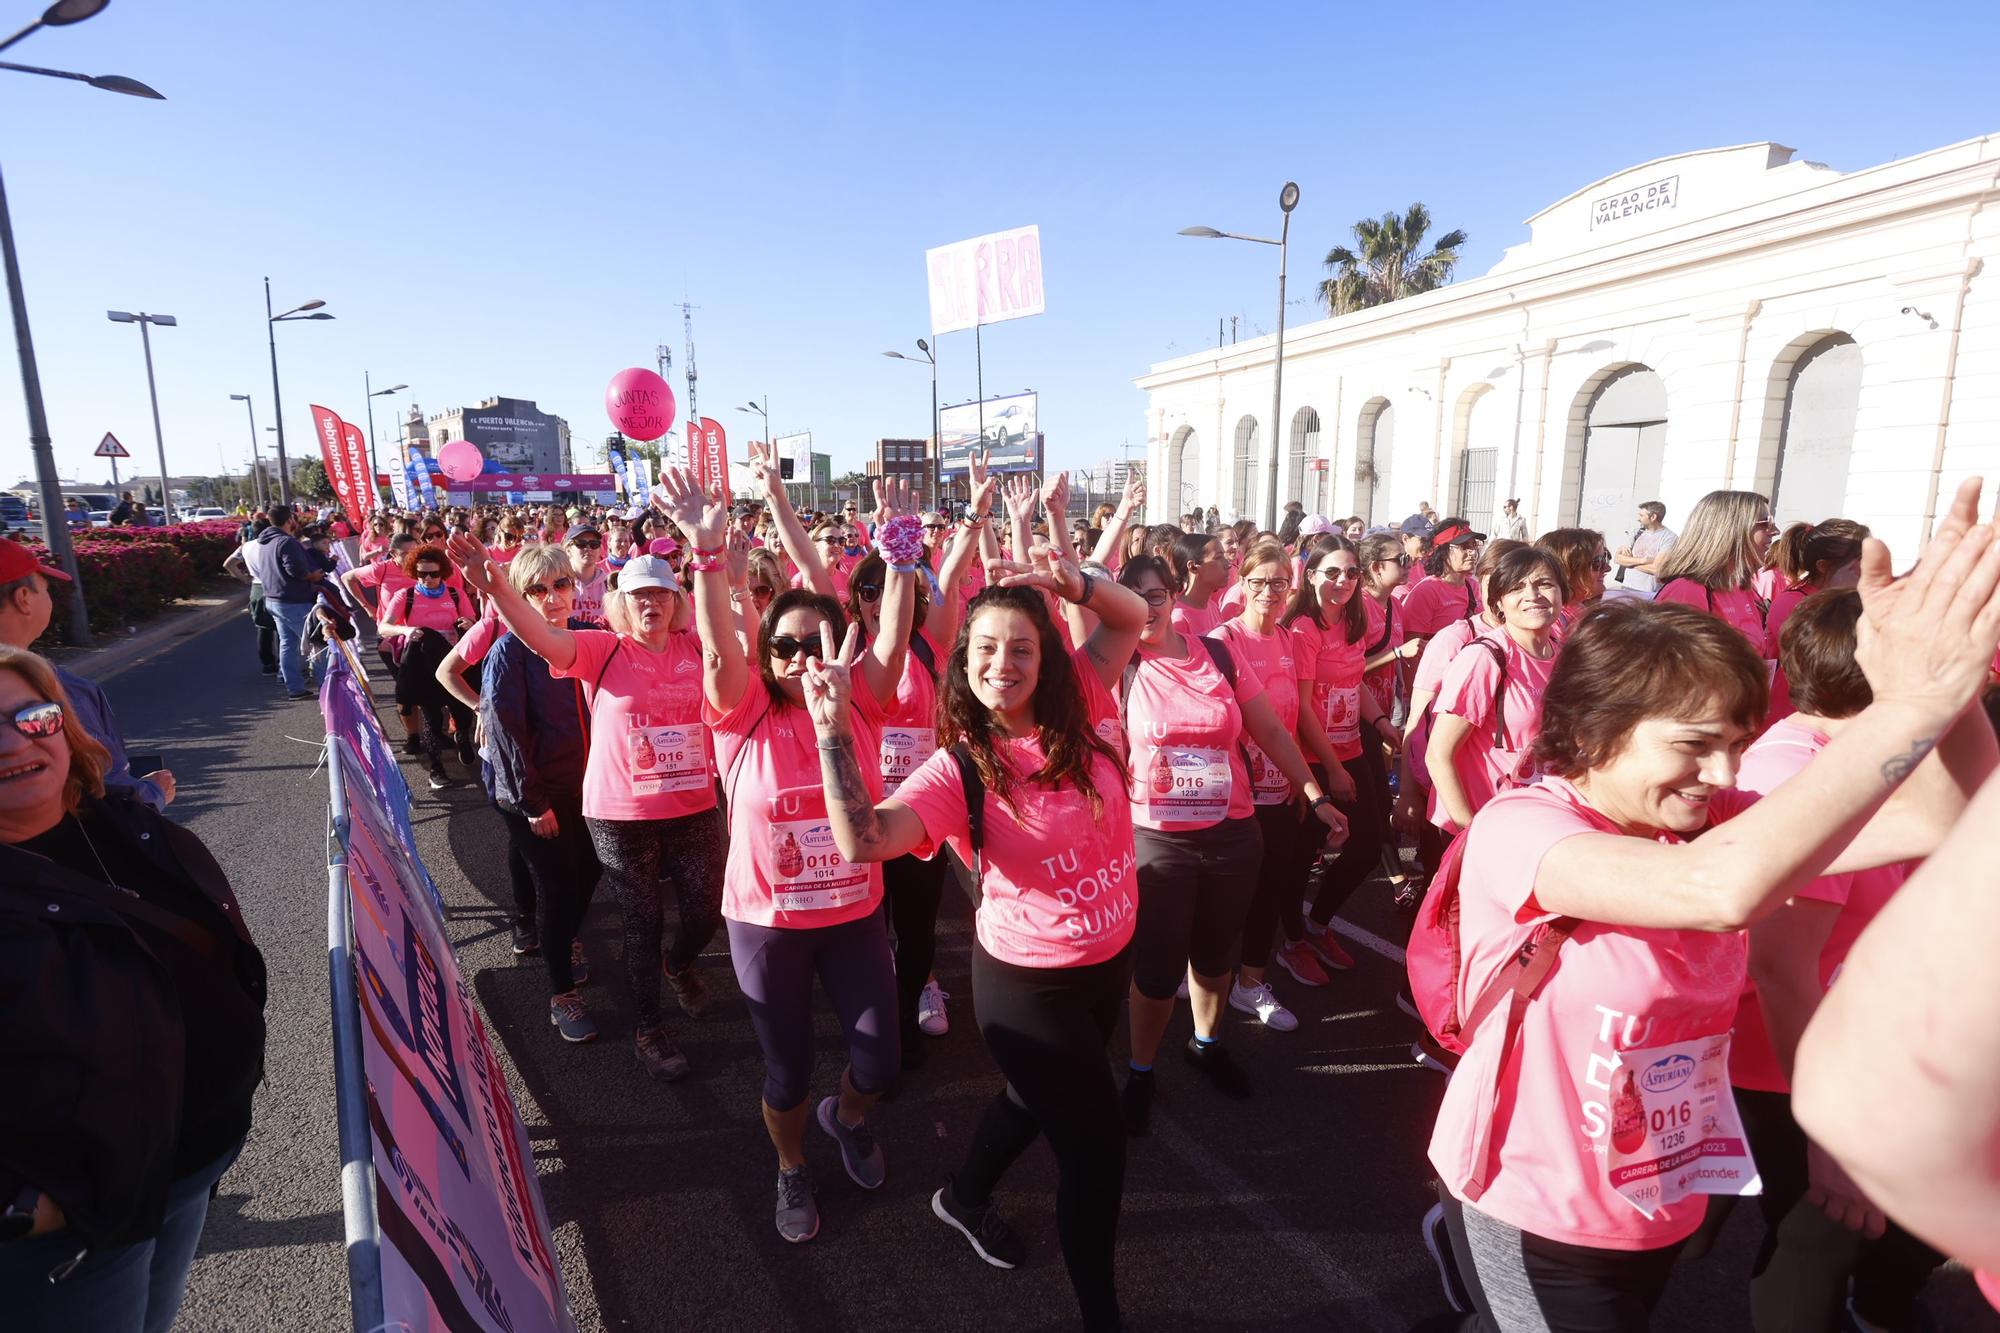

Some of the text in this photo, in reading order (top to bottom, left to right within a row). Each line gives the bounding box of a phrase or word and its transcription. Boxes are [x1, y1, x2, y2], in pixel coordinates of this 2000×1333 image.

[1599, 182, 1670, 212] GRAO DE
[1595, 195, 1671, 224] VALENCIA
[615, 389, 659, 408] JUNTAS
[632, 405, 646, 415] ES
[479, 416, 503, 425] PUERTO
[619, 415, 664, 429] MEJOR
[625, 713, 649, 728] TU
[1142, 721, 1167, 738] TU
[658, 751, 684, 763] 016
[884, 755, 911, 765] 016
[1176, 777, 1204, 788] 016
[768, 796, 800, 817] TU
[806, 852, 841, 868] 016
[1041, 848, 1078, 879] TU
[814, 869, 835, 879] 1014
[831, 879, 851, 888] MUJER
[1056, 842, 1136, 908] DORSAL
[782, 896, 814, 905] OYSHO
[1065, 891, 1132, 939] SUMA
[1595, 1004, 1654, 1047] TU
[1645, 1065, 1691, 1087] ASTURIANA
[478, 1082, 491, 1104] a
[1651, 1101, 1691, 1132] 016
[1660, 1131, 1685, 1150] 1236
[1620, 1164, 1659, 1180] CARRERA
[1659, 1161, 1670, 1170] DE
[1671, 1158, 1680, 1167] LA
[1702, 1143, 1726, 1153] 2023
[1686, 1168, 1740, 1184] Santander
[484, 1105, 540, 1276] Kilómetro
